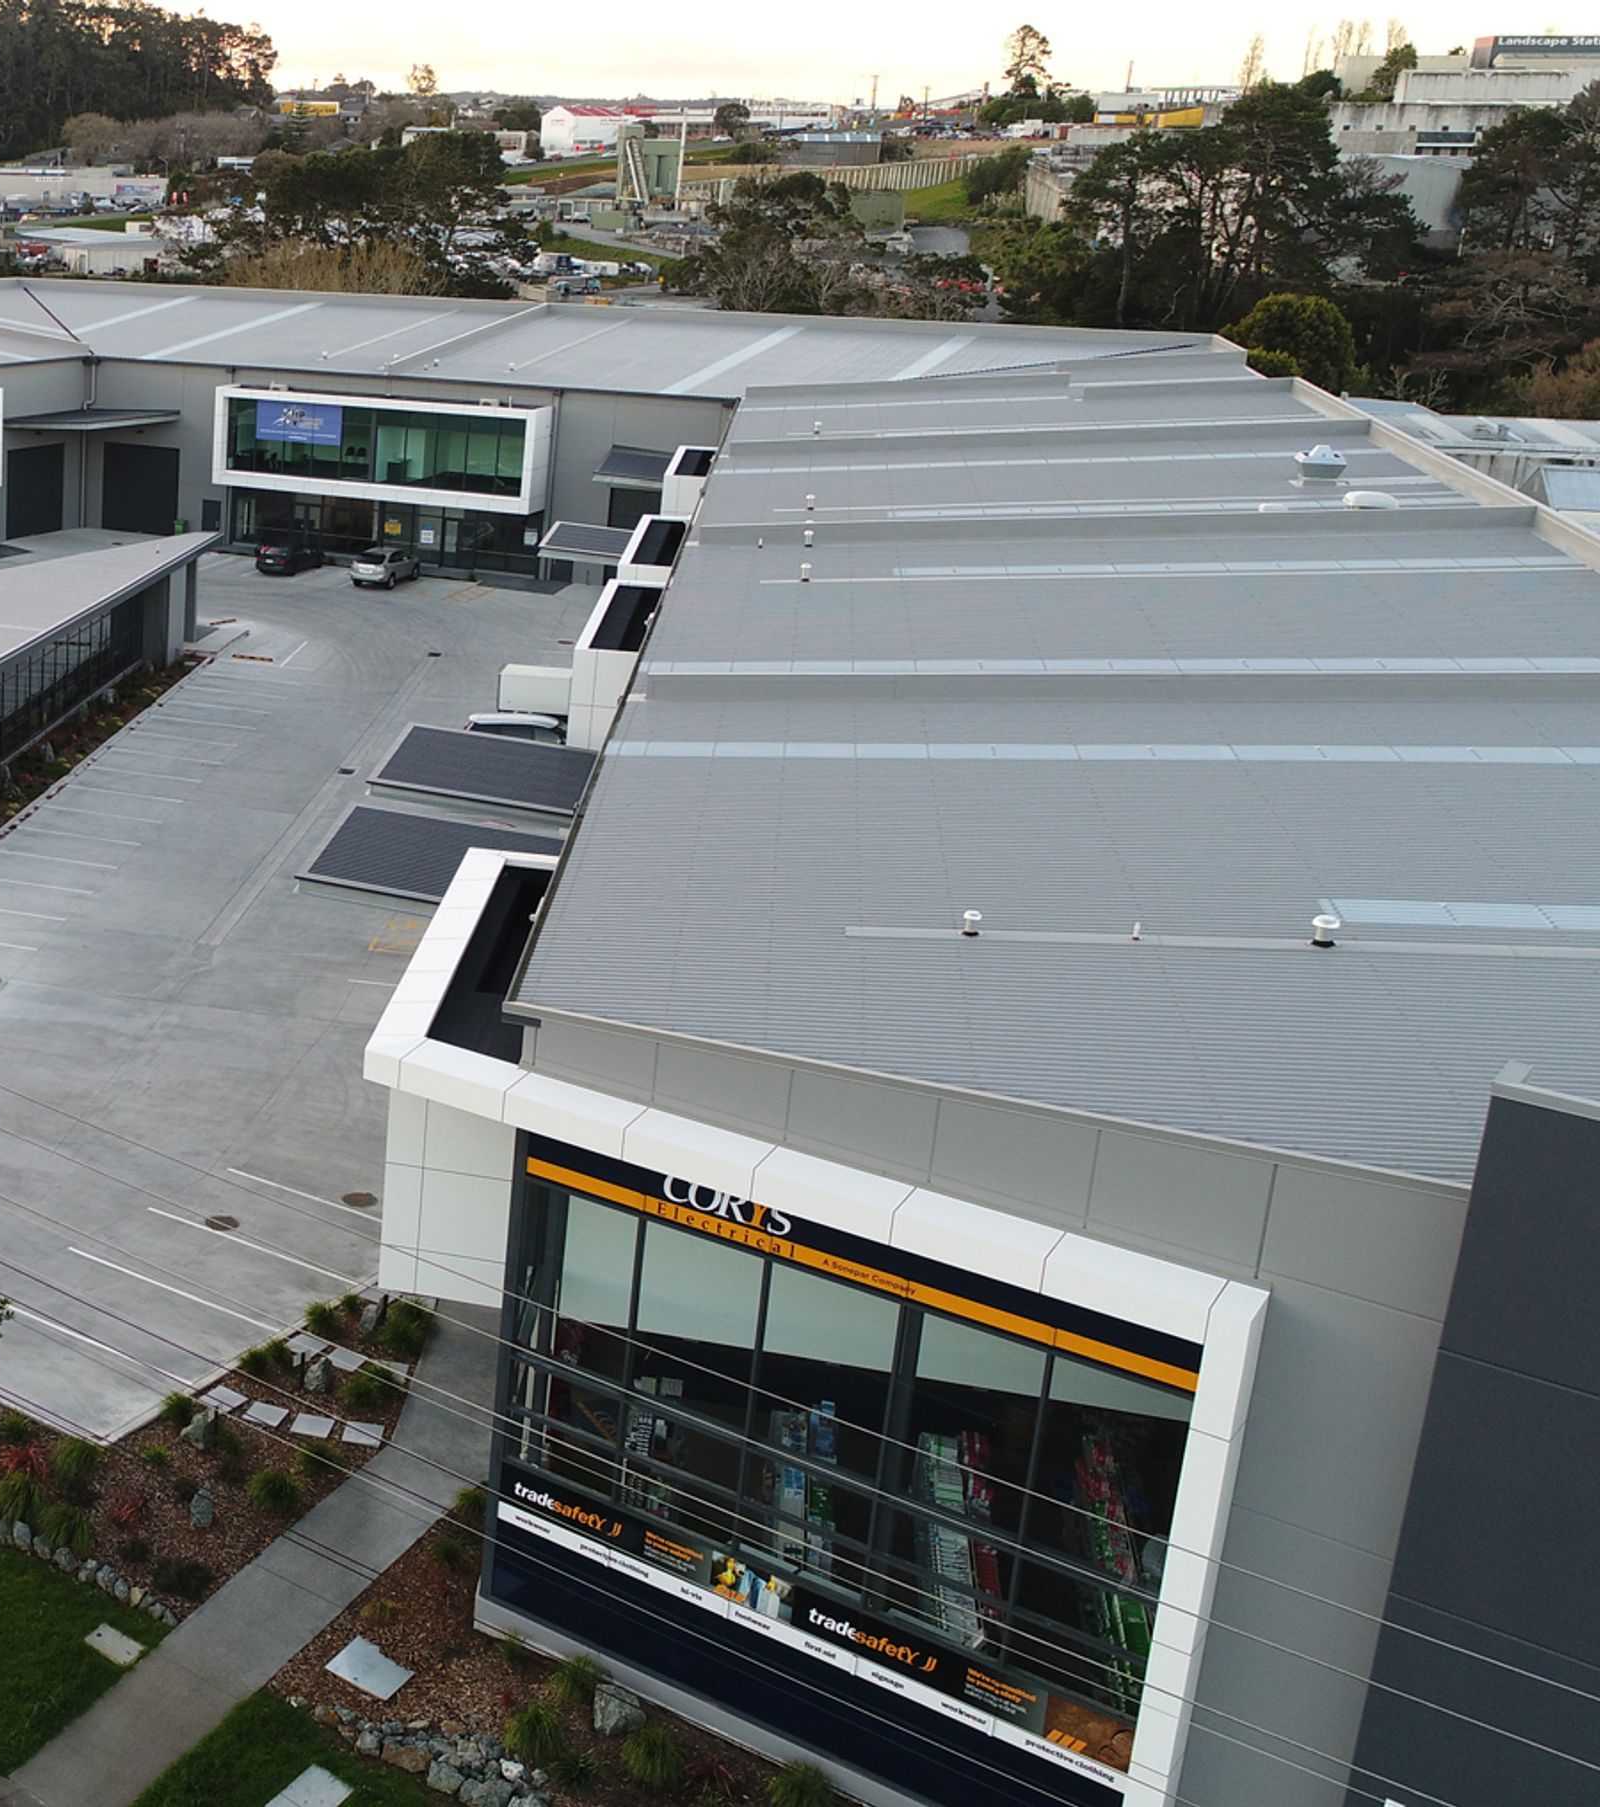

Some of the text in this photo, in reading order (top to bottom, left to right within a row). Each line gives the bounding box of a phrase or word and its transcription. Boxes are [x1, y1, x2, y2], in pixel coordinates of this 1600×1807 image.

[1498, 36, 1568, 48] Landscape
[663, 1174, 792, 1236] CORYS
[657, 1202, 796, 1258] Electrical
[831, 1260, 870, 1278] Sonepar
[871, 1274, 916, 1296] Company
[681, 1586, 703, 1601] hi-vis
[734, 1610, 771, 1631] footwear
[804, 1641, 837, 1660] first aid
[871, 1671, 905, 1690] signage
[941, 1701, 986, 1725] workwear
[1025, 1739, 1115, 1783] protective clothing
